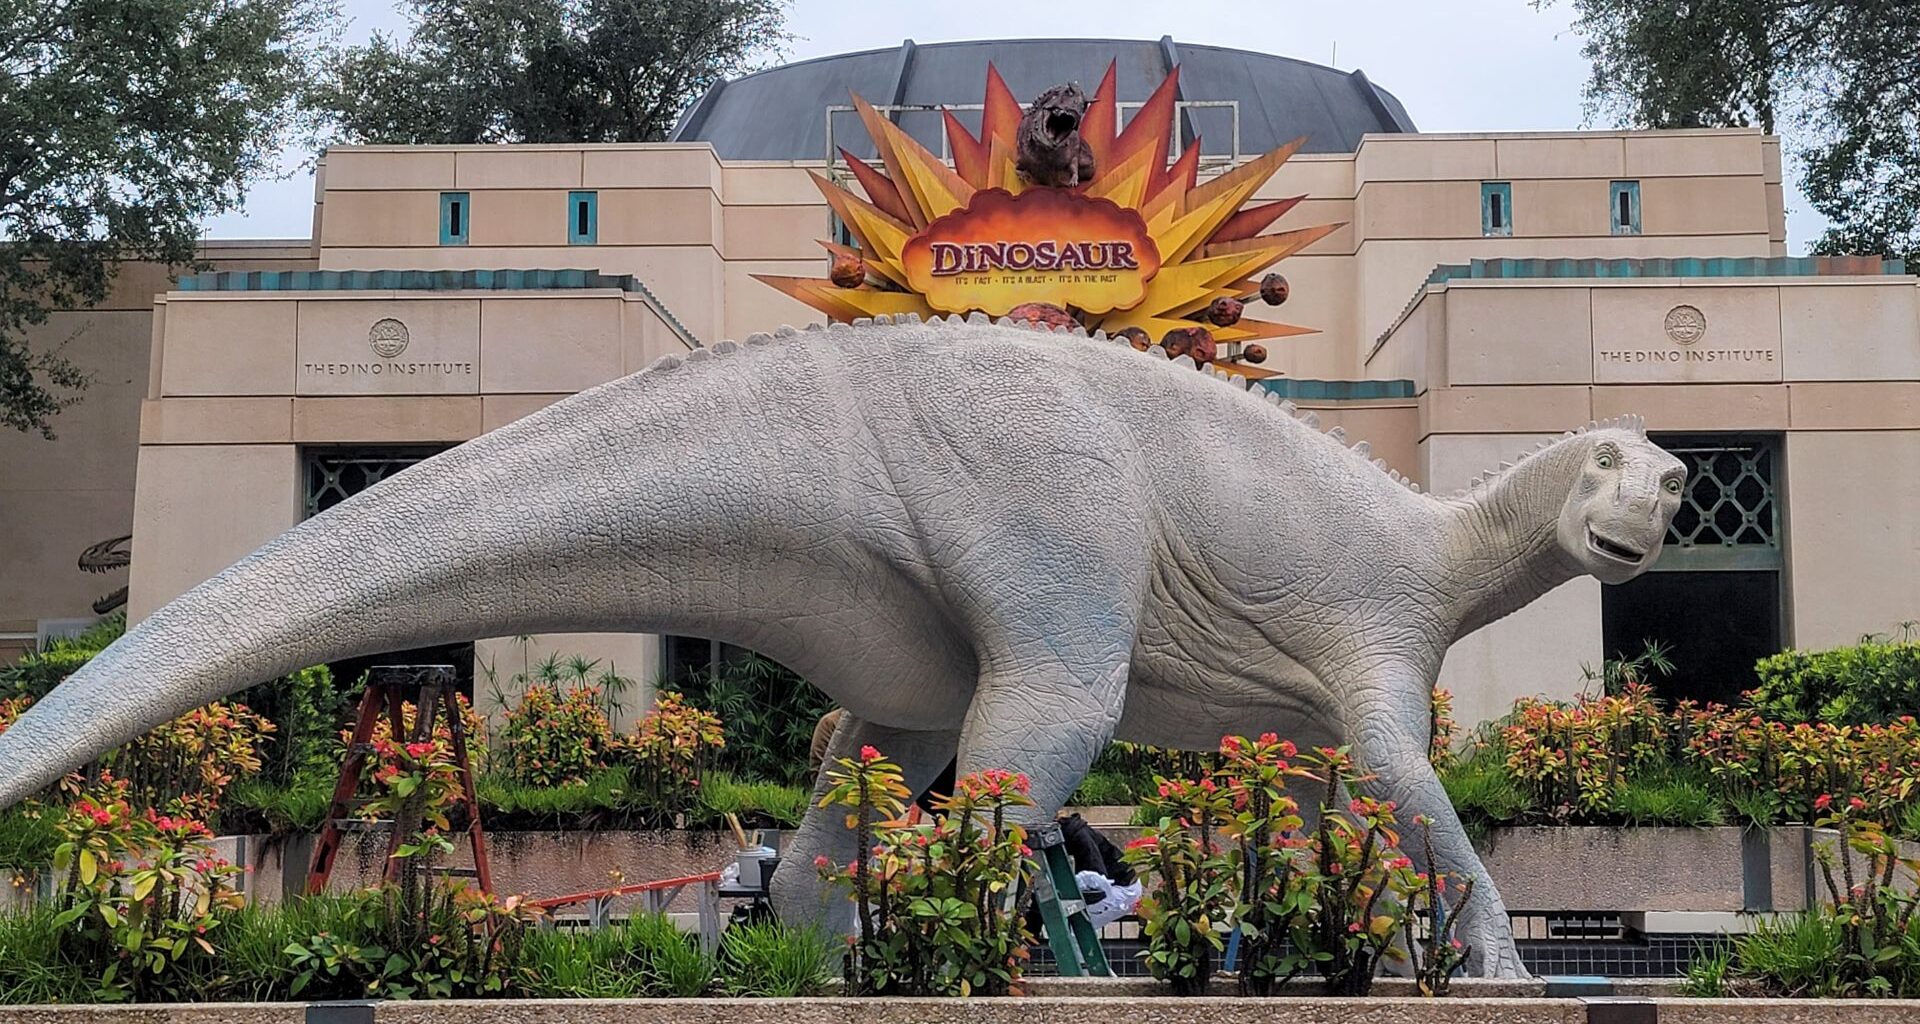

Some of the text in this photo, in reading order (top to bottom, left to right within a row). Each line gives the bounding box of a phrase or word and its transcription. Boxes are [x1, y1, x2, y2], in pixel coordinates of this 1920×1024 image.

[931, 241, 1138, 275] DINOSAUR
[1084, 275, 1097, 283] THE
[1600, 350, 1773, 362] THE DINO INSTITUTE
[305, 363, 472, 375] THE DINO INSTITUTE
